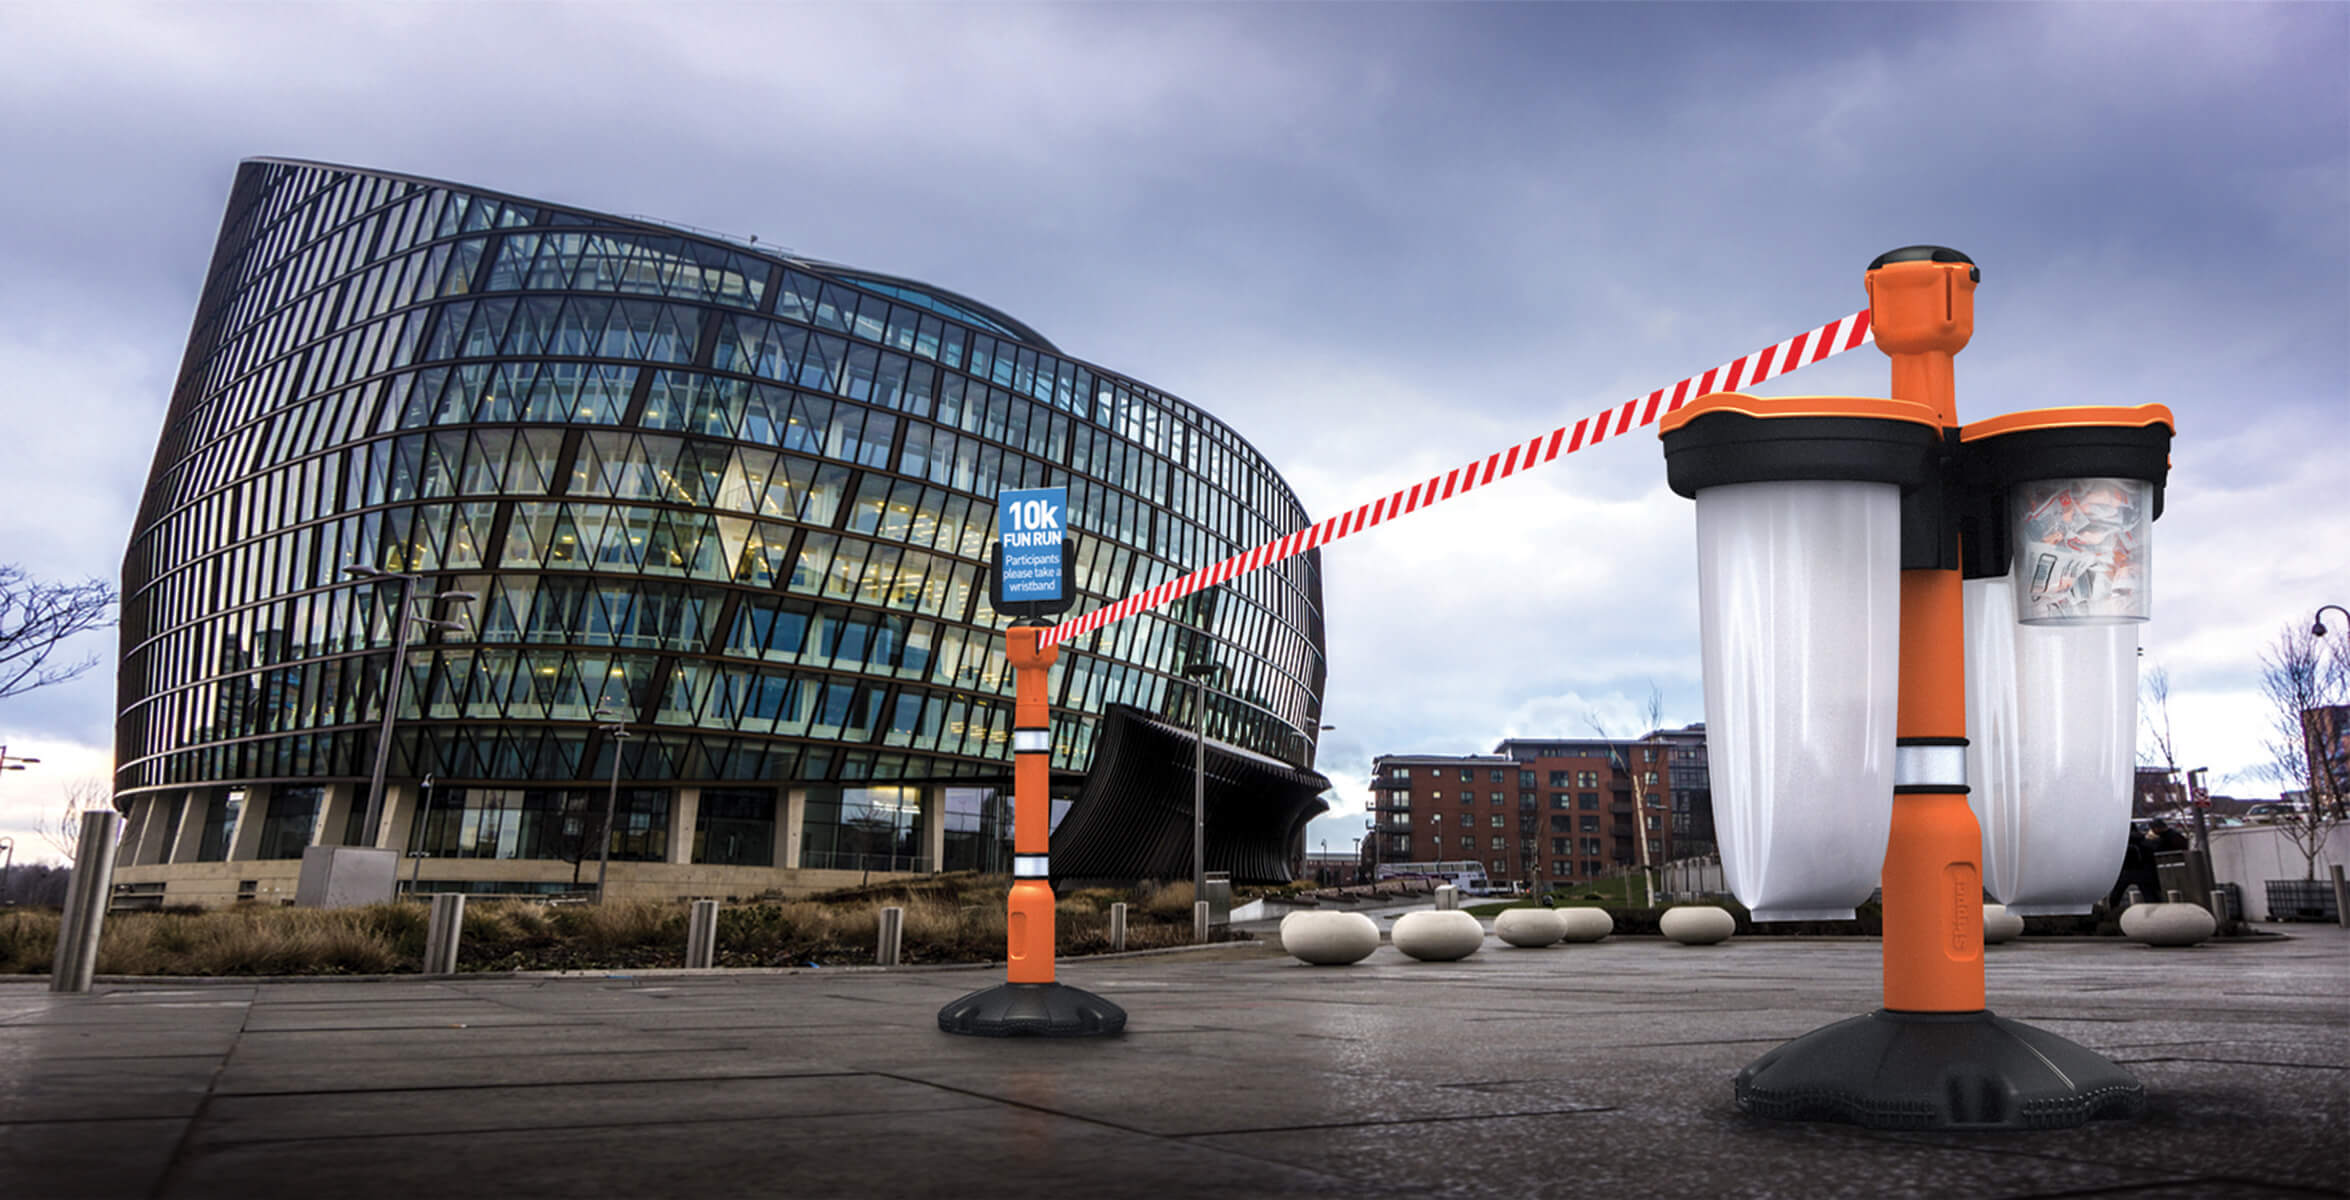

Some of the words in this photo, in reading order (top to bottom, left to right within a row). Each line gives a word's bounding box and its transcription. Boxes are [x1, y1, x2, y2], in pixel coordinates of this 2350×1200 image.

[1009, 500, 1059, 531] 10k
[1004, 533, 1031, 547] FUN
[1033, 531, 1062, 545] RUN
[1006, 554, 1060, 566] Participants
[1003, 568, 1033, 582] please
[1035, 567, 1055, 578] take
[1056, 568, 1062, 577] a
[1009, 581, 1055, 592] wristband
